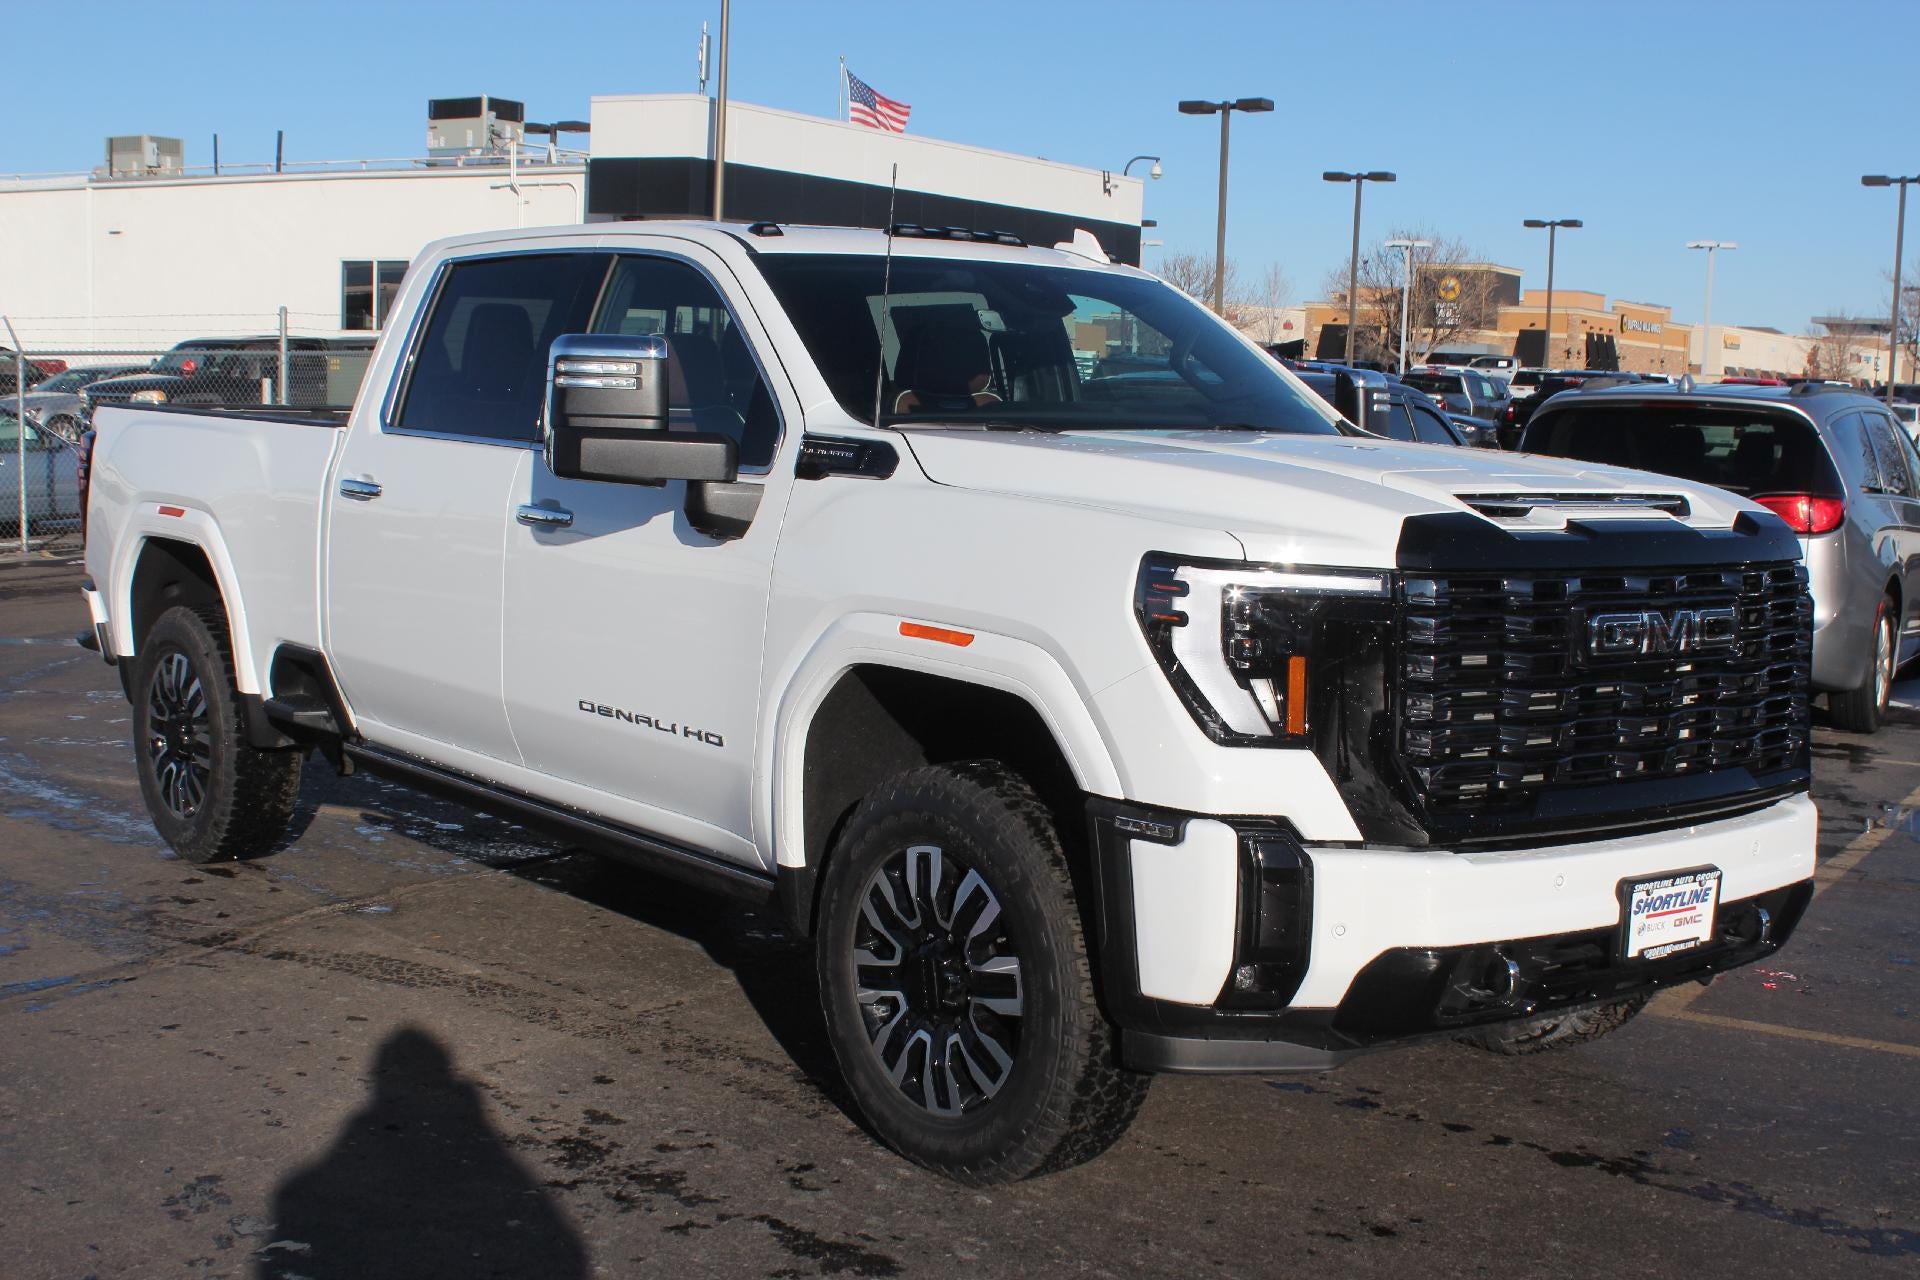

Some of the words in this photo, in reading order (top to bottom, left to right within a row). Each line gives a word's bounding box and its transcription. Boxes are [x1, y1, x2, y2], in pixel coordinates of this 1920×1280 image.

[1590, 609, 1735, 654] GMC
[579, 700, 677, 734] DENALI
[683, 726, 724, 747] HD
[1633, 879, 1673, 892] SHORTLINE
[1674, 876, 1694, 886] AUTO
[1696, 871, 1721, 881] GROUP
[1633, 887, 1712, 915] SHORTLINE
[1647, 921, 1664, 932] BUICK
[1673, 914, 1703, 927] GMC
